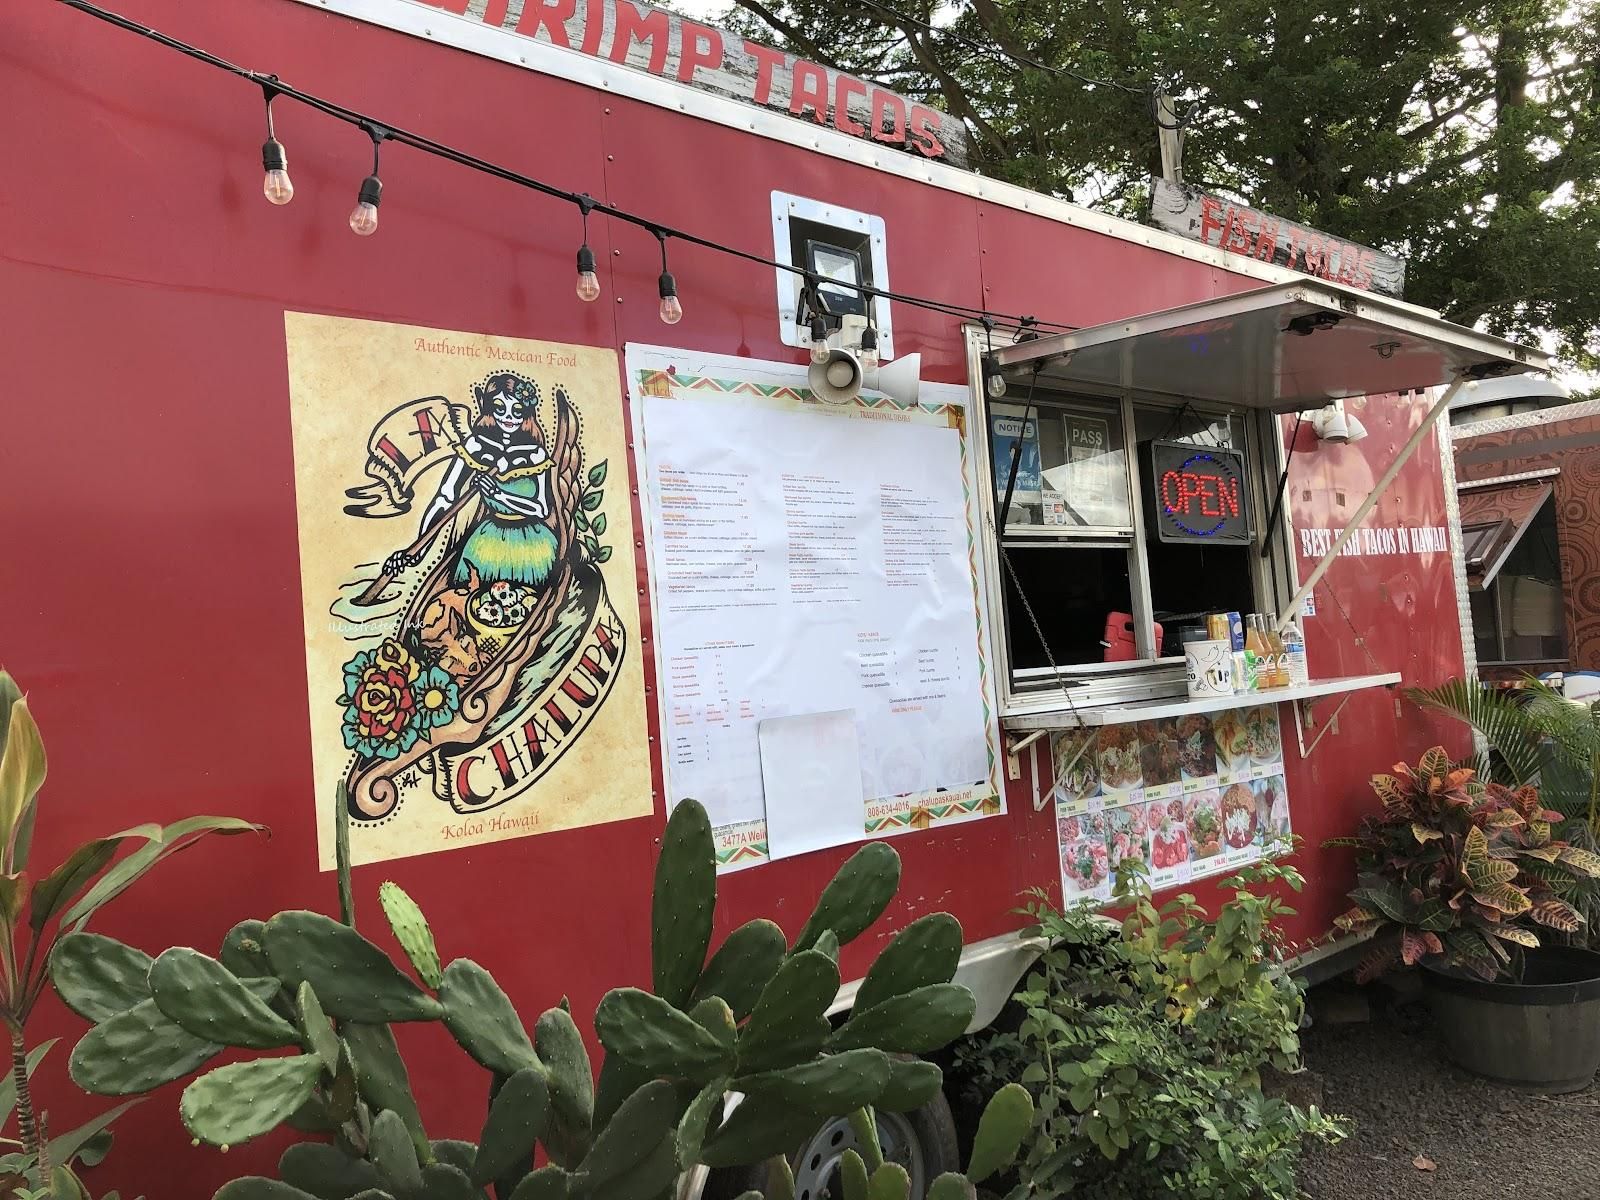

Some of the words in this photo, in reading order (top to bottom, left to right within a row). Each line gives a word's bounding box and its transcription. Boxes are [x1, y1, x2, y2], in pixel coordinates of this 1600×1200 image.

[413, 0, 721, 83] RIMP
[741, 39, 944, 157] TACOS
[1200, 195, 1280, 263] FISH
[414, 337, 481, 357] Authentic
[486, 345, 542, 364] Mexican
[546, 352, 577, 367] Food
[1072, 428, 1103, 446] PASS
[1162, 470, 1239, 517] OPEN
[1300, 528, 1331, 557] BEST
[1362, 528, 1397, 556] TACOS
[1398, 527, 1409, 554] IN
[1410, 526, 1448, 553] HAWAII
[456, 616, 621, 806] CHALUPA
[867, 800, 910, 818] 808-634-4016
[442, 815, 483, 839] Koloa
[488, 811, 540, 832] Hawaii
[722, 833, 747, 848] 3477A
